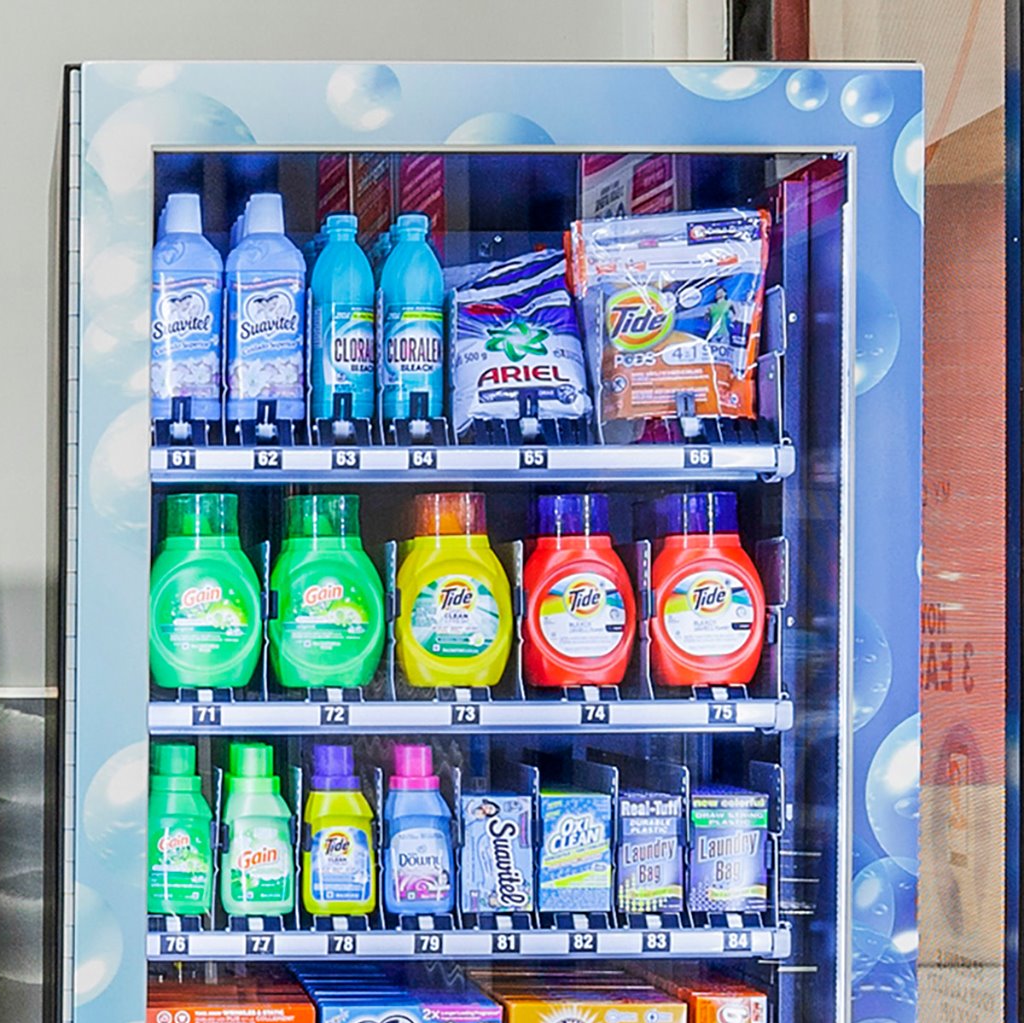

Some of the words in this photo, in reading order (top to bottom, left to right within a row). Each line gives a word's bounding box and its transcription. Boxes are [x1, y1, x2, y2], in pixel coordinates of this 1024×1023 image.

[240, 315, 297, 340] Suavitel
[611, 305, 667, 339] Tide
[334, 338, 374, 362] CLORA
[478, 364, 571, 388] ARIEL
[172, 450, 192, 466] 61
[257, 450, 279, 466] 62
[336, 450, 356, 466] 63
[413, 450, 433, 466] 64
[523, 449, 544, 465] 65
[690, 449, 710, 464] 66
[181, 585, 222, 608] Gain
[303, 584, 344, 608] Gain
[441, 587, 473, 610] Tide
[569, 588, 601, 612] Tide
[694, 586, 726, 611] Tide
[196, 706, 216, 722] 71
[324, 706, 345, 722] 72
[455, 705, 476, 722] 73
[584, 705, 606, 721] 74
[711, 704, 733, 720] 75
[561, 817, 590, 833] OXI
[325, 838, 351, 855] Tide
[551, 827, 599, 852] CLEAN
[699, 831, 758, 861] Laundry
[237, 847, 278, 869] Gain
[625, 838, 677, 865] Laundry
[488, 819, 525, 905] Suavitel
[639, 864, 661, 884] Bag
[716, 860, 742, 882] Bag
[165, 936, 186, 952] 76
[250, 936, 272, 952] 77
[333, 935, 354, 952] 78
[419, 935, 440, 951] 79
[497, 934, 515, 950] 81
[573, 933, 593, 949] 82
[647, 933, 667, 949] 83
[728, 933, 748, 949] 84
